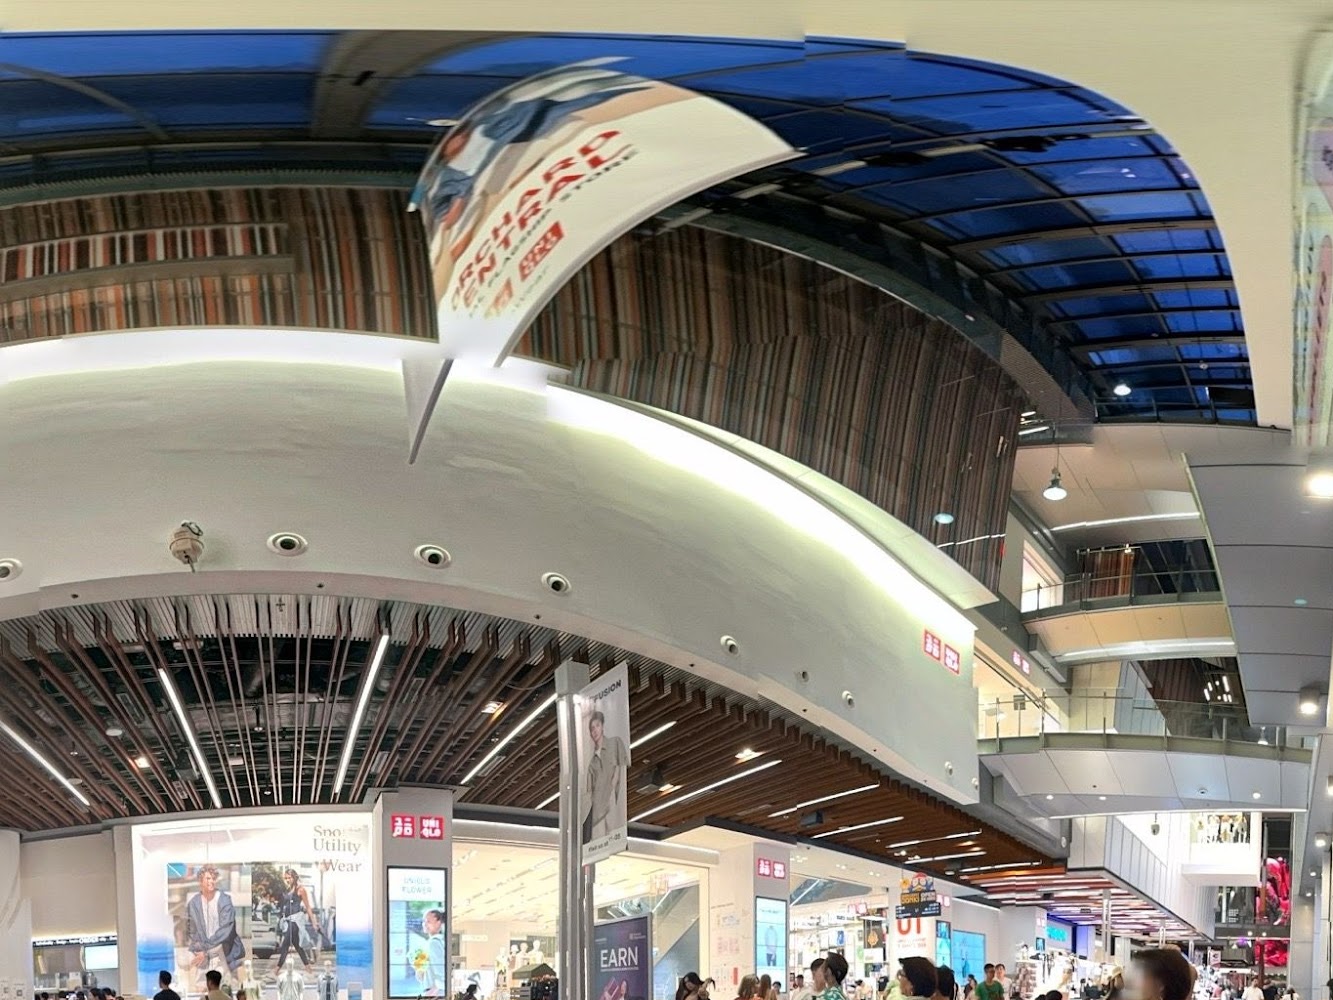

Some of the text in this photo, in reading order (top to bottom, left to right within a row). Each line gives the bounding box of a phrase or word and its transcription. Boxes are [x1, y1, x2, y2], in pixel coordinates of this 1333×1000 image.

[462, 143, 634, 309] ENTRAL
[313, 838, 362, 856] Utility
[322, 859, 363, 873] Wear
[402, 886, 432, 895] FLOWER
[600, 945, 639, 968] EARN
